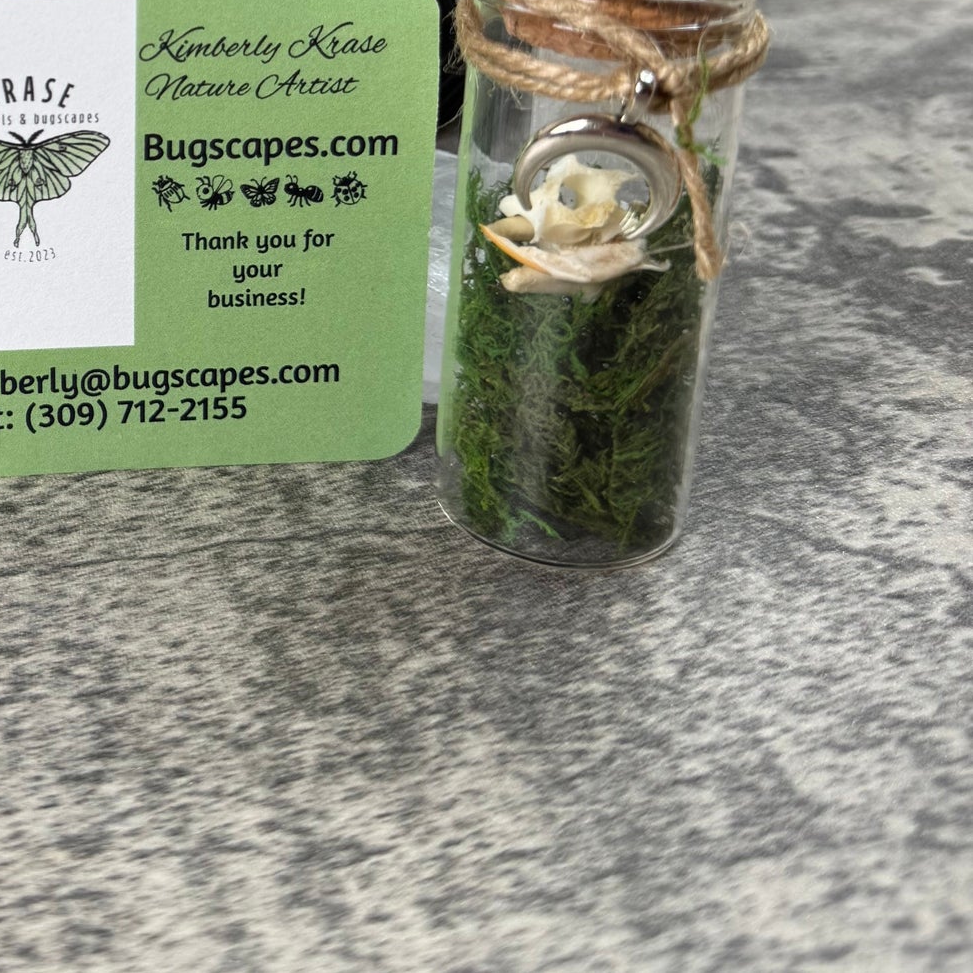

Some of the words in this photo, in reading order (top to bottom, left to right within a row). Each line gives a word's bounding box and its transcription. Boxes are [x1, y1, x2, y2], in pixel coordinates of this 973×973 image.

[139, 25, 281, 64] Kimberly
[288, 21, 388, 59] Krase
[144, 73, 251, 101] Nature
[255, 69, 359, 99] Artist
[19, 114, 26, 125] &
[34, 112, 100, 126] bugscapes
[144, 133, 398, 168] Bugscapes.com
[181, 231, 249, 251] Thank
[255, 233, 297, 254] you
[303, 229, 335, 252] for
[232, 262, 283, 284] your
[207, 287, 306, 308] business!
[25, 402, 108, 434] (309)
[117, 396, 247, 424] 712-2155
